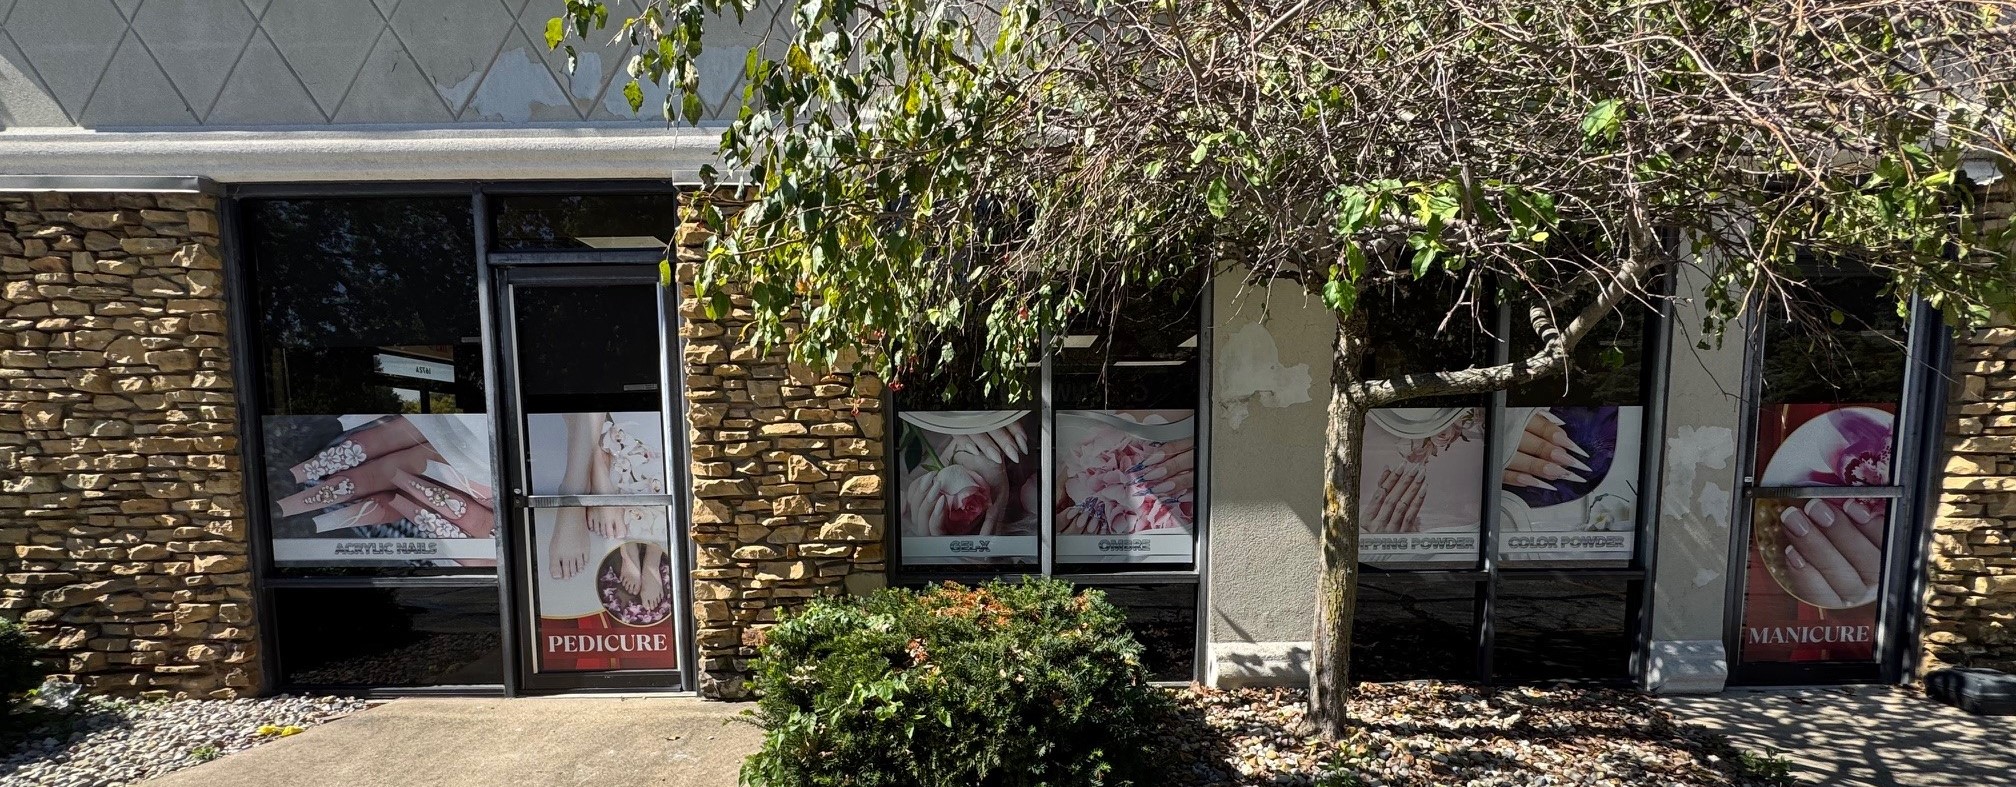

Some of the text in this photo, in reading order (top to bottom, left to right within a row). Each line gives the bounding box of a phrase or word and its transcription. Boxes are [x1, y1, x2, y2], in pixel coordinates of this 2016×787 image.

[335, 542, 437, 555] ACRYLIC NAILS
[949, 540, 991, 552] GEL-X
[1098, 538, 1151, 551] OMBRE
[1359, 536, 1475, 550] IPPING POWDER
[1508, 536, 1624, 549] COLOR POWDER
[1749, 625, 1870, 644] MANICURE
[549, 634, 667, 653] PEDICURE
